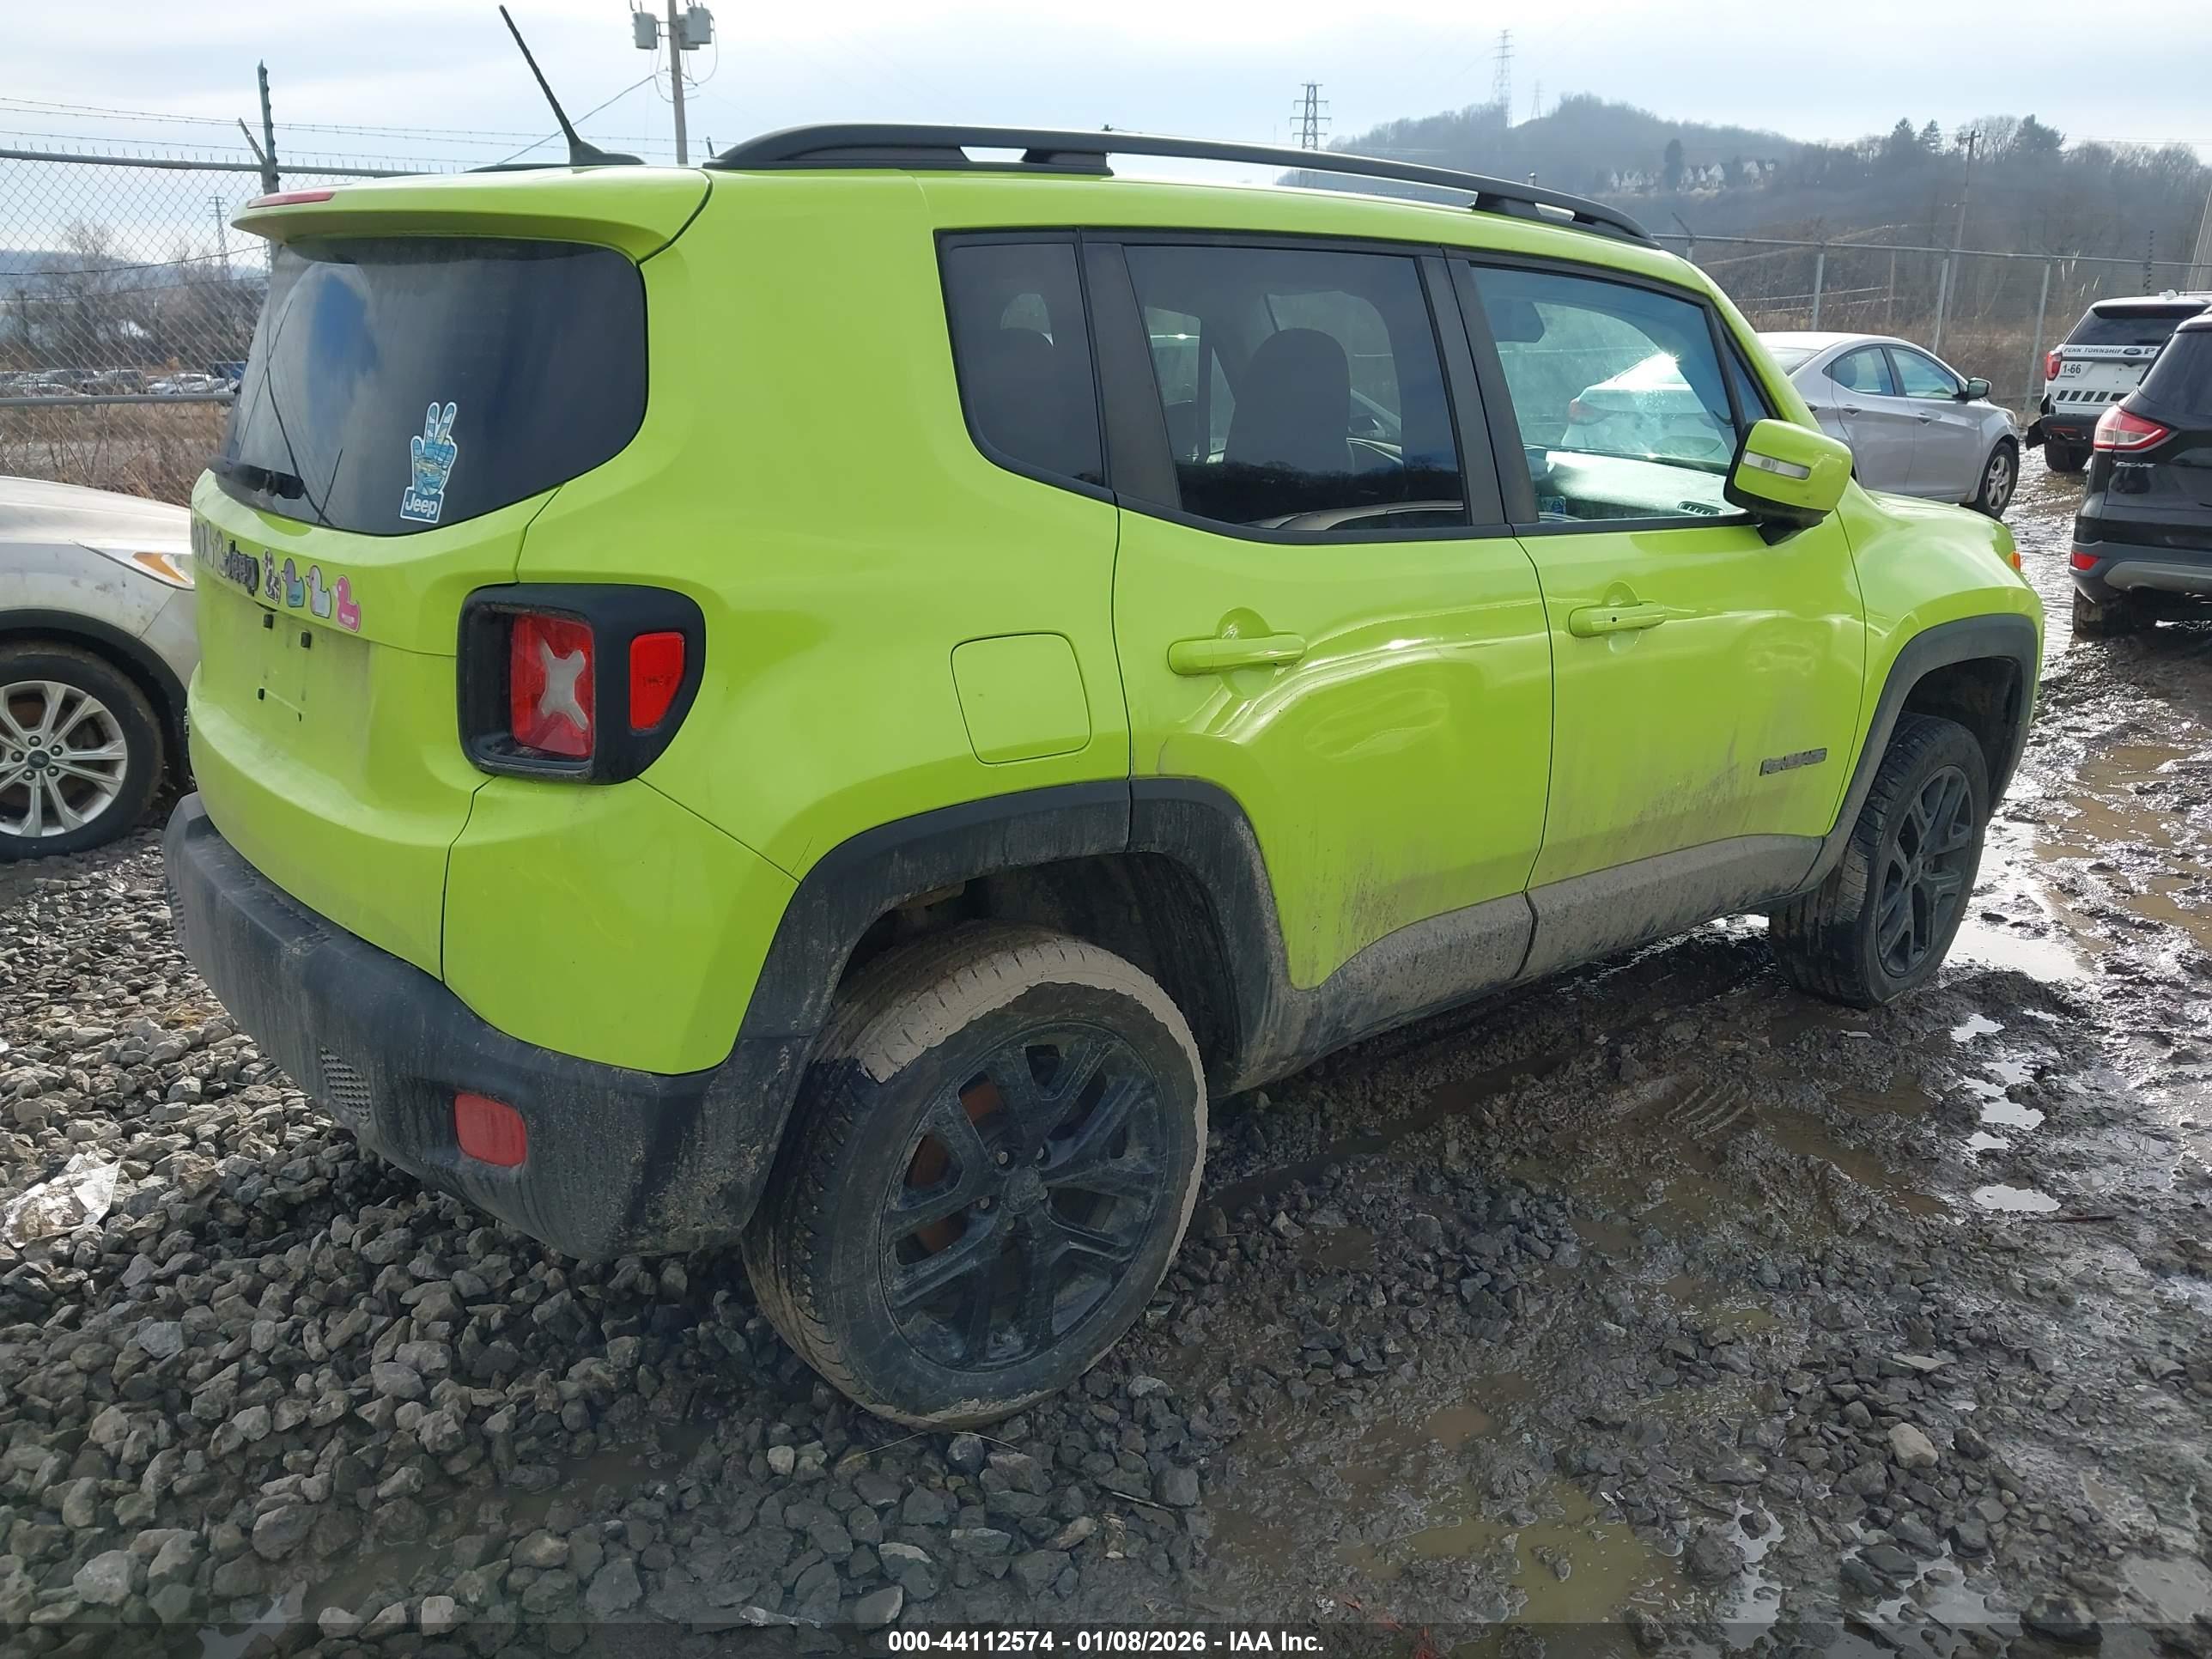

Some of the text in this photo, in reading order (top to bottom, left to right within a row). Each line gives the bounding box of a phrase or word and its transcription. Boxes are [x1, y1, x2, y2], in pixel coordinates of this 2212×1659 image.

[2063, 363, 2081, 374] 1-66
[404, 492, 439, 519] Jeep
[225, 539, 259, 597] Jeep
